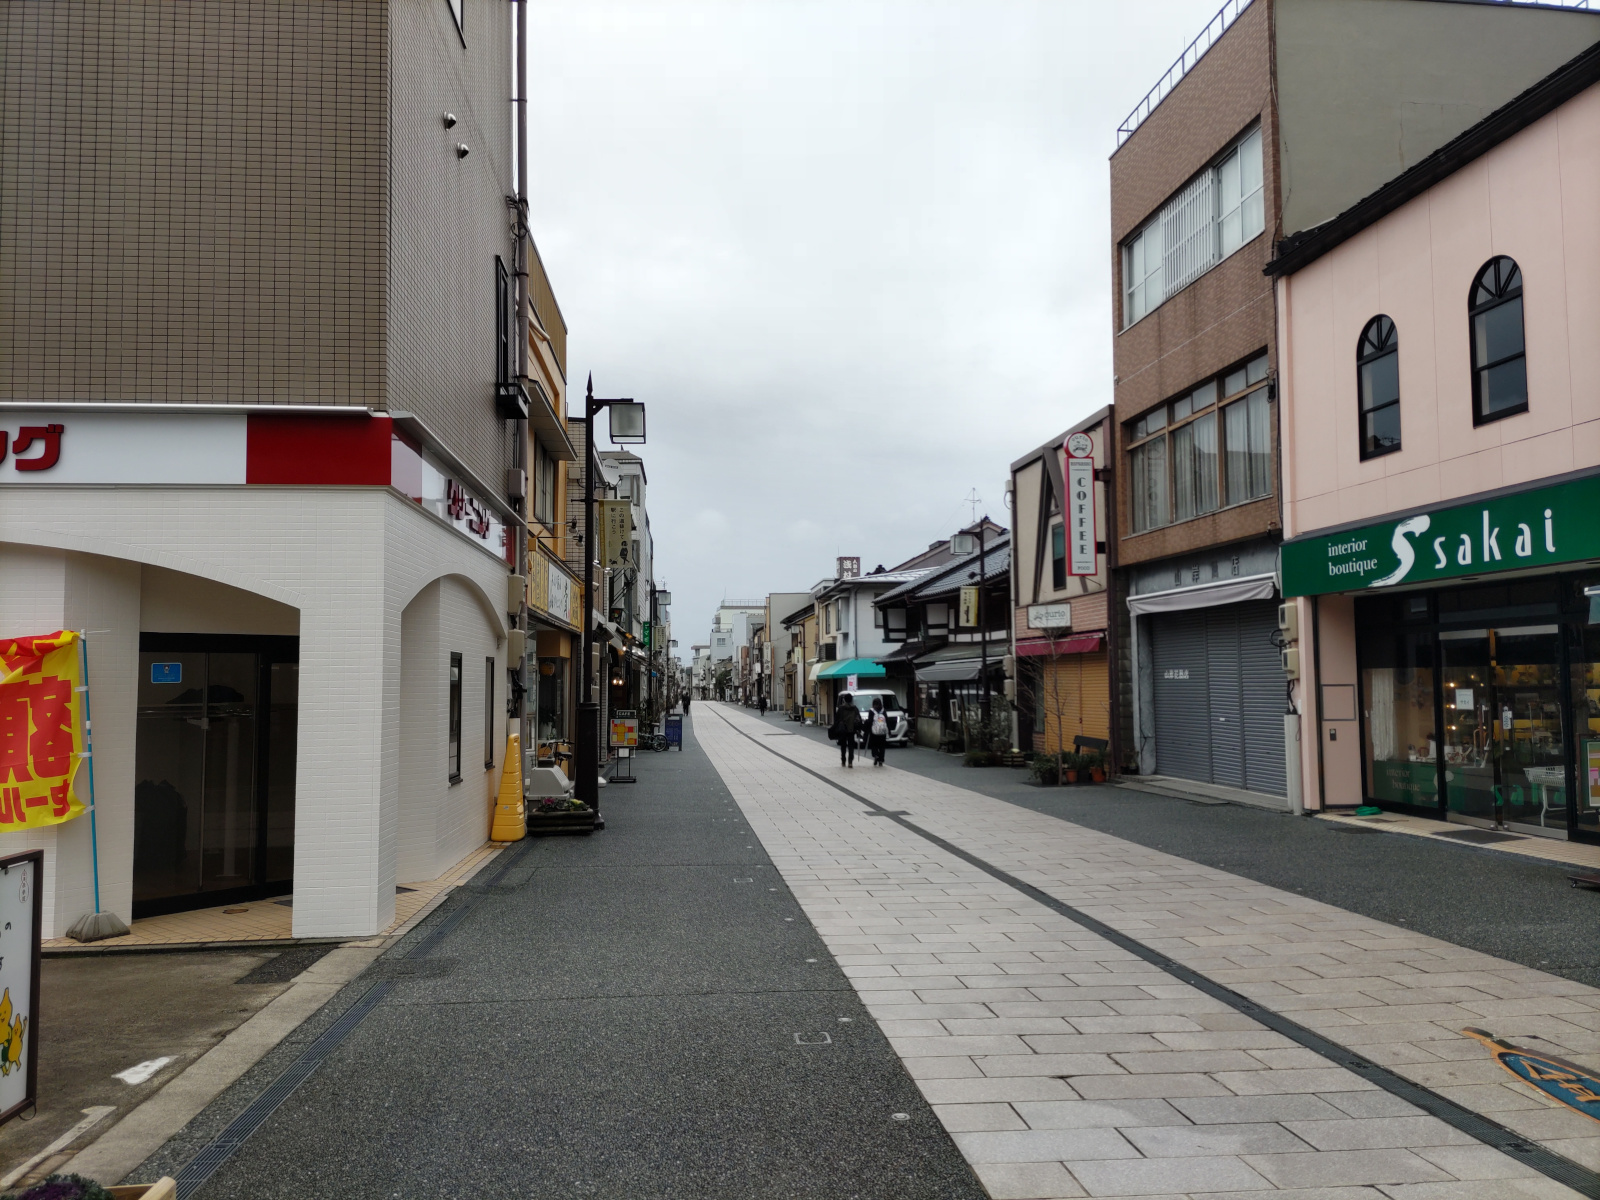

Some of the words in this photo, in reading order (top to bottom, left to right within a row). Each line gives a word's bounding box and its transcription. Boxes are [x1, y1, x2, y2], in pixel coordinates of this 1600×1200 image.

[0, 424, 64, 471] グ
[1076, 477, 1088, 554] COFFEE
[1433, 509, 1556, 569] sakai
[1328, 538, 1368, 557] interior
[1328, 556, 1378, 576] boutique
